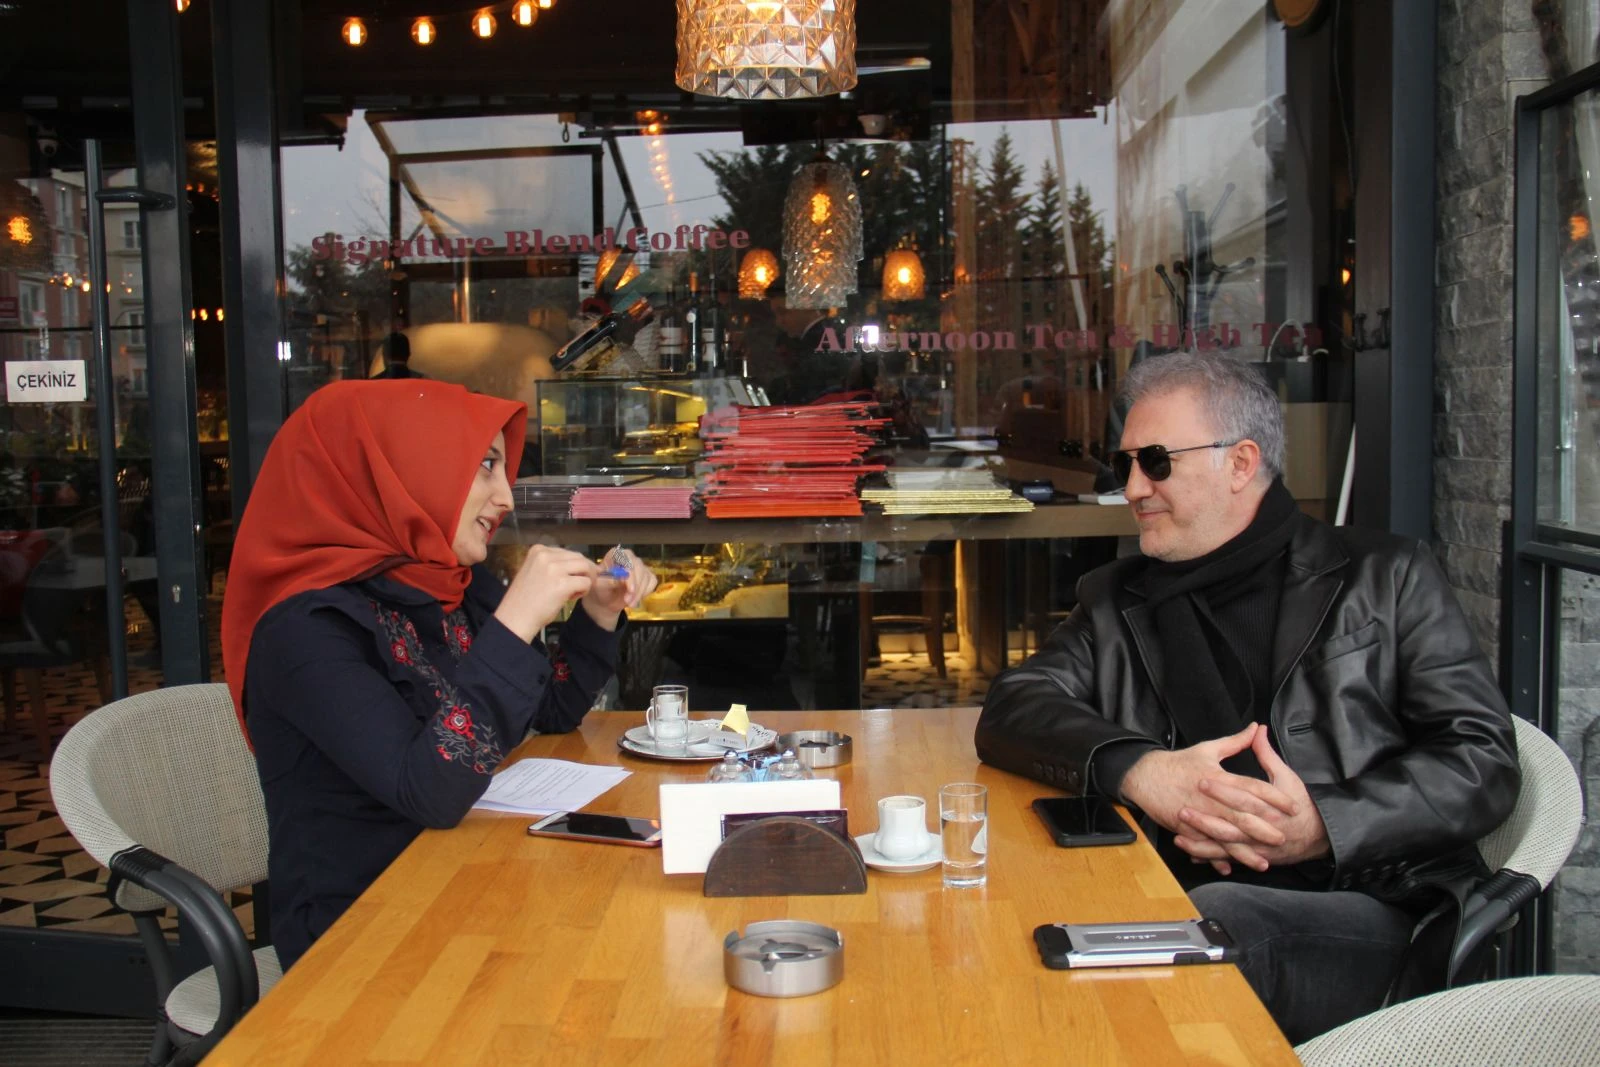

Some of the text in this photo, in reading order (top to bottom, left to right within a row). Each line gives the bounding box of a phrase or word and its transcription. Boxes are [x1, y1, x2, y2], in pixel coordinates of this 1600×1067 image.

[311, 224, 750, 266] Signature Blend Coffee
[813, 322, 1324, 354] Afternoon Tea & High Tea
[17, 371, 76, 391] ÇEKİNİZ
